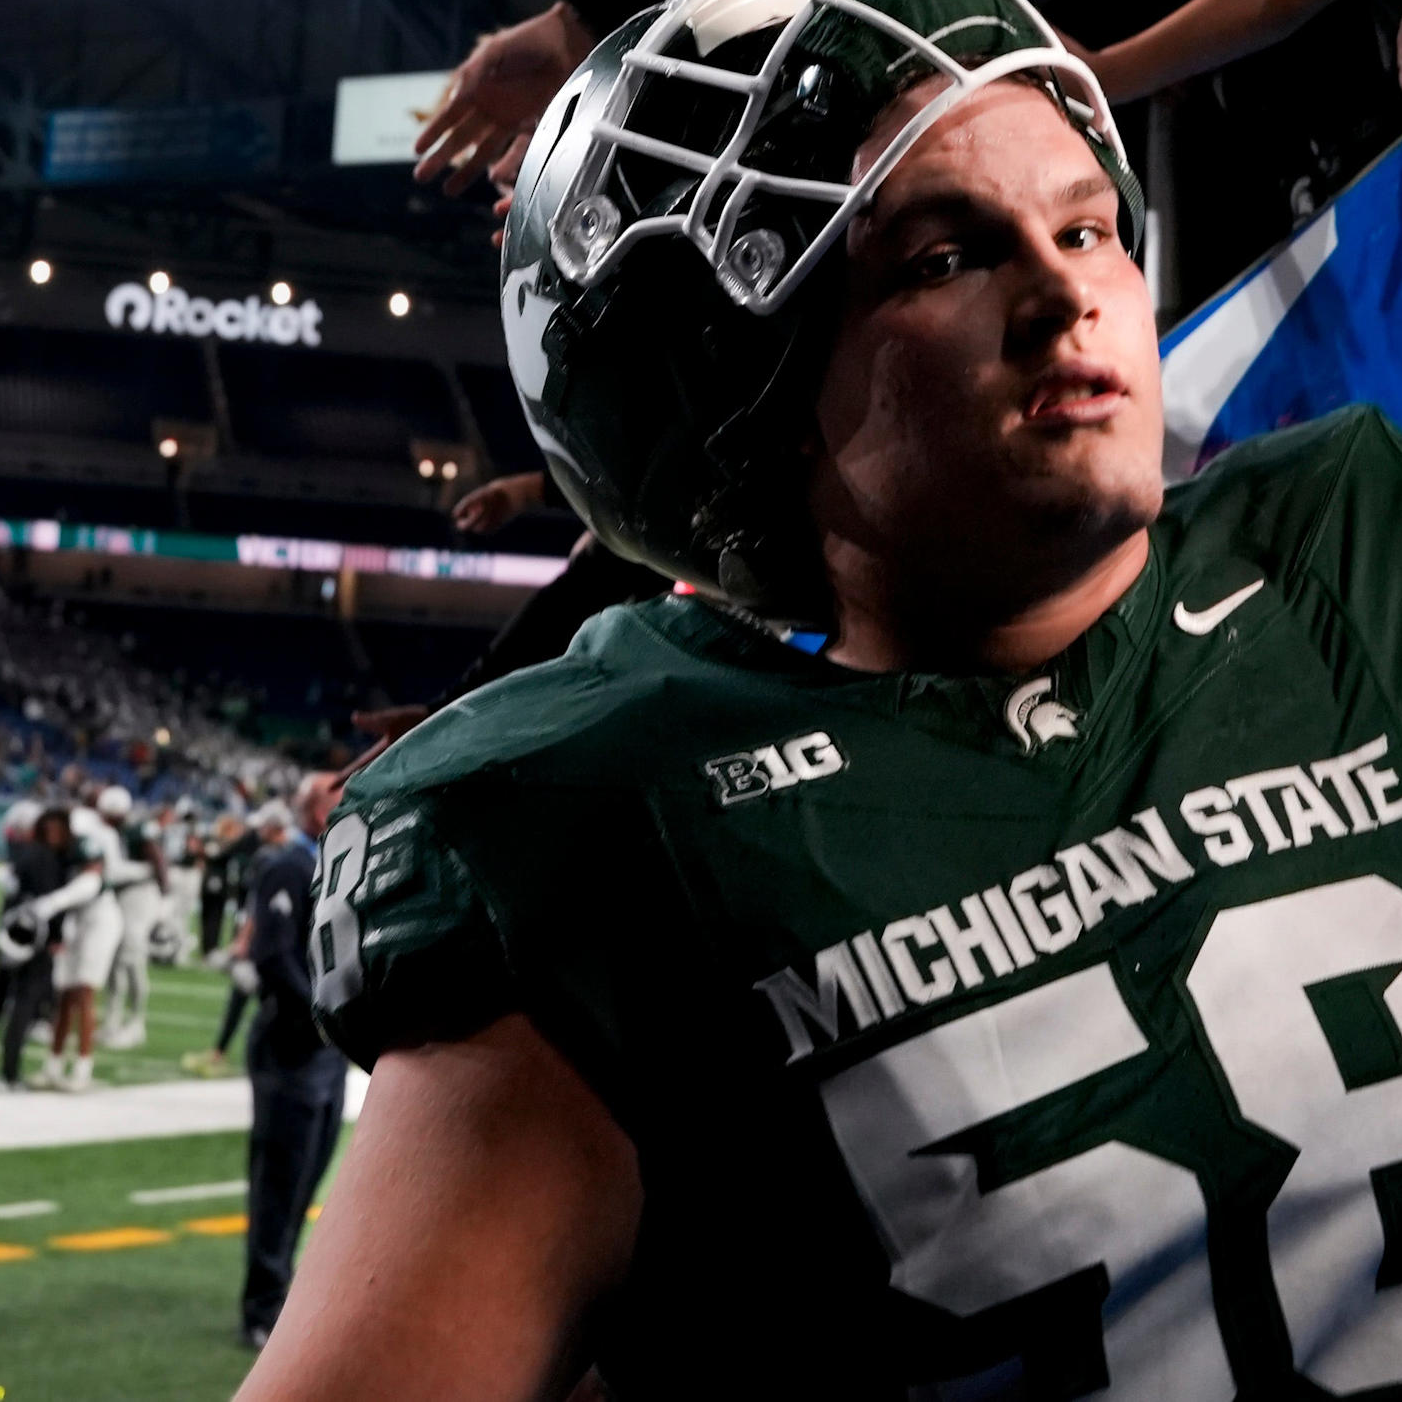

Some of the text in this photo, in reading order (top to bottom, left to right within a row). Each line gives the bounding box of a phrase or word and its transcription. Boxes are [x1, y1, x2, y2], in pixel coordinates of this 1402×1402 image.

[152, 284, 323, 347] Rocket
[307, 811, 369, 1014] 8
[753, 806, 1196, 1066] MICHIGAN
